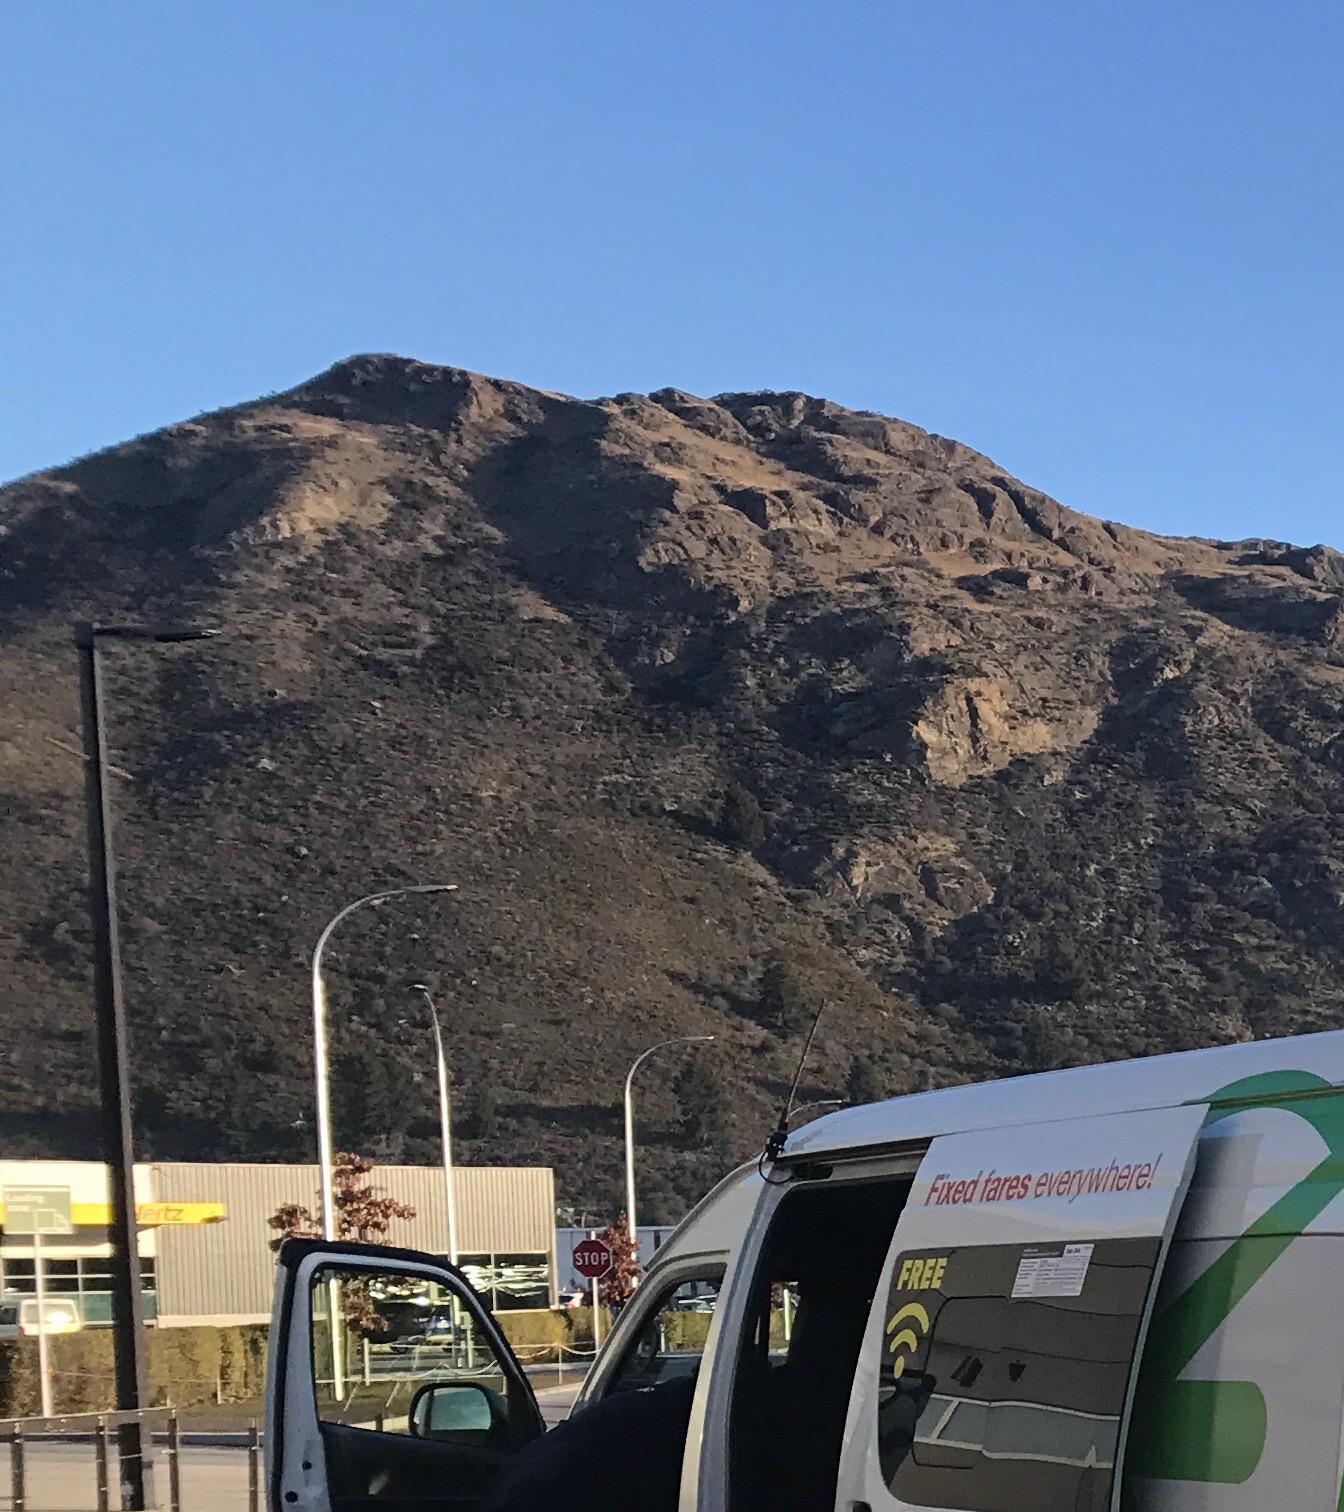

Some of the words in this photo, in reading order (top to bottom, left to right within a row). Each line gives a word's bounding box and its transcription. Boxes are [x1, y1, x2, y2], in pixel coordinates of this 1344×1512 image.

[924, 1170, 983, 1206] Fixed
[980, 1169, 1032, 1202] fares
[1033, 1152, 1164, 1204] everywhere!
[574, 1252, 608, 1266] STOP
[896, 1258, 947, 1290] FREE
